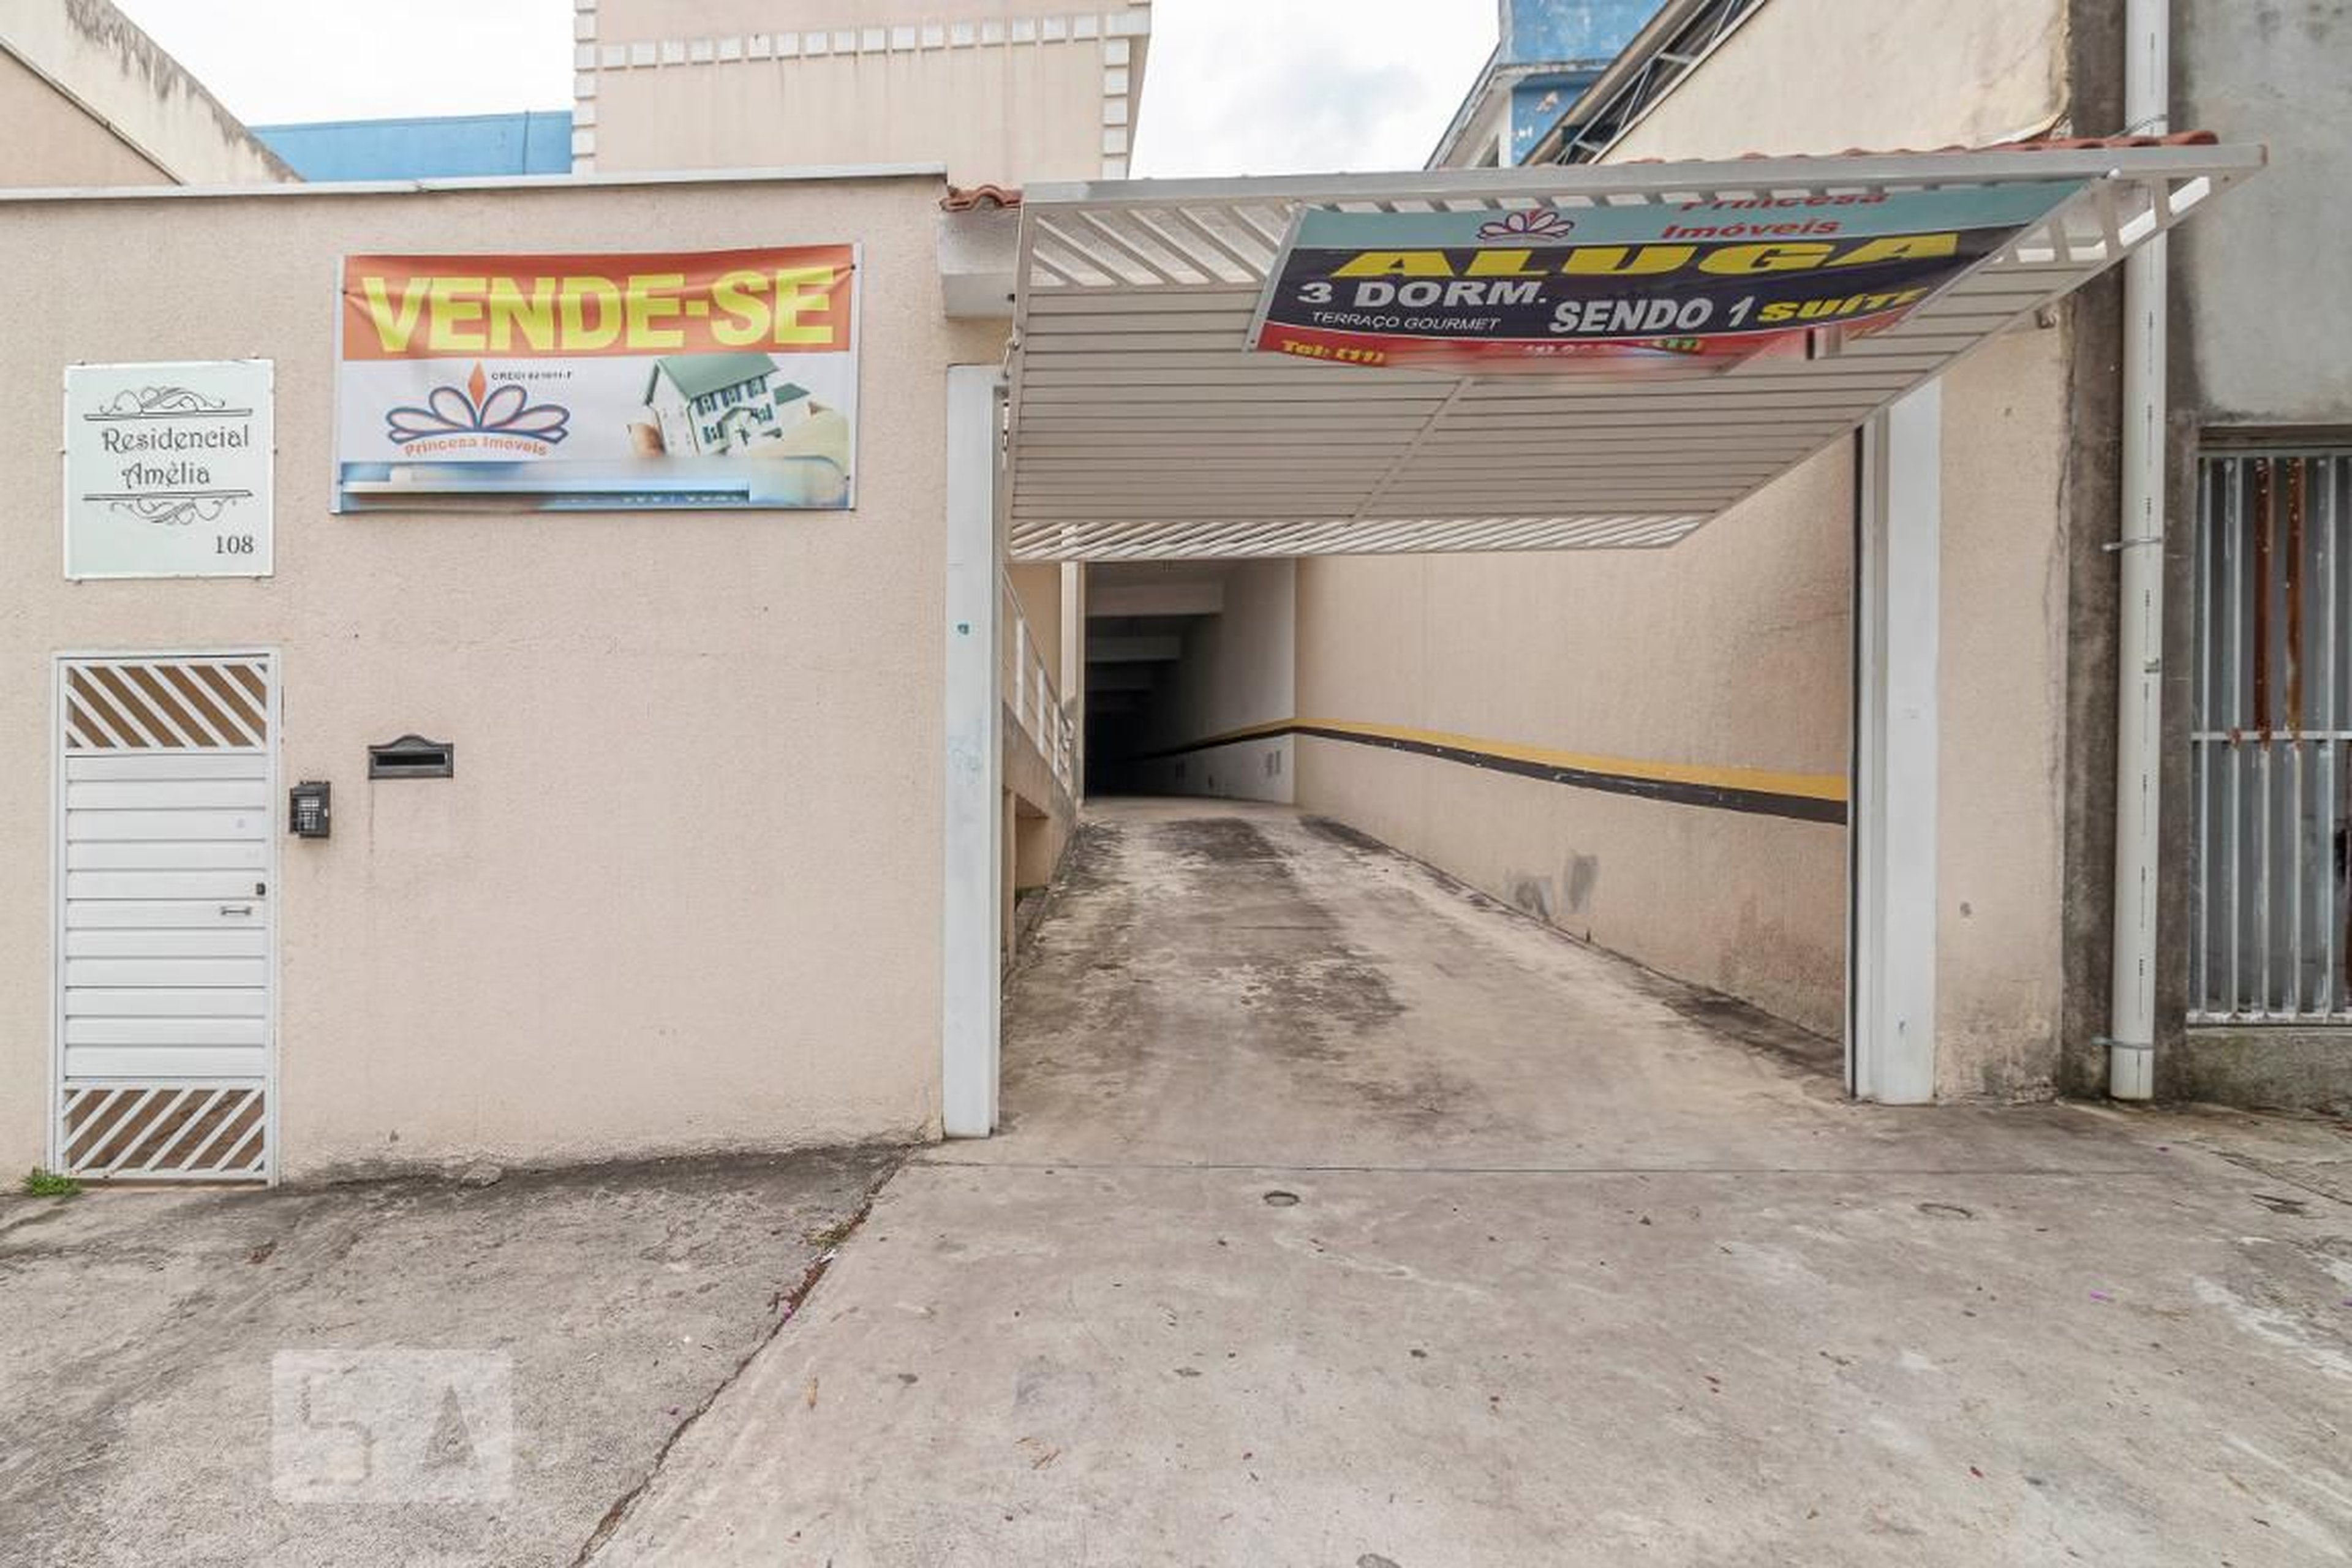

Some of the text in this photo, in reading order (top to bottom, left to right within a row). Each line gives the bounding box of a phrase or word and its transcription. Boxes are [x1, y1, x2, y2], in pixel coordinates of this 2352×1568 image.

[1660, 218, 1841, 239] Imóveis
[1329, 232, 1961, 277] ALUGA
[1297, 280, 1548, 308] 3 DORM.
[361, 268, 835, 353] VENDE-SE
[1311, 311, 1501, 331] TERRAÇO GOURMET
[1548, 296, 1714, 334] SENDO
[1728, 295, 1755, 328] 1
[102, 424, 249, 454] Residencial
[404, 438, 478, 457] Princesa
[215, 535, 254, 556] 108
